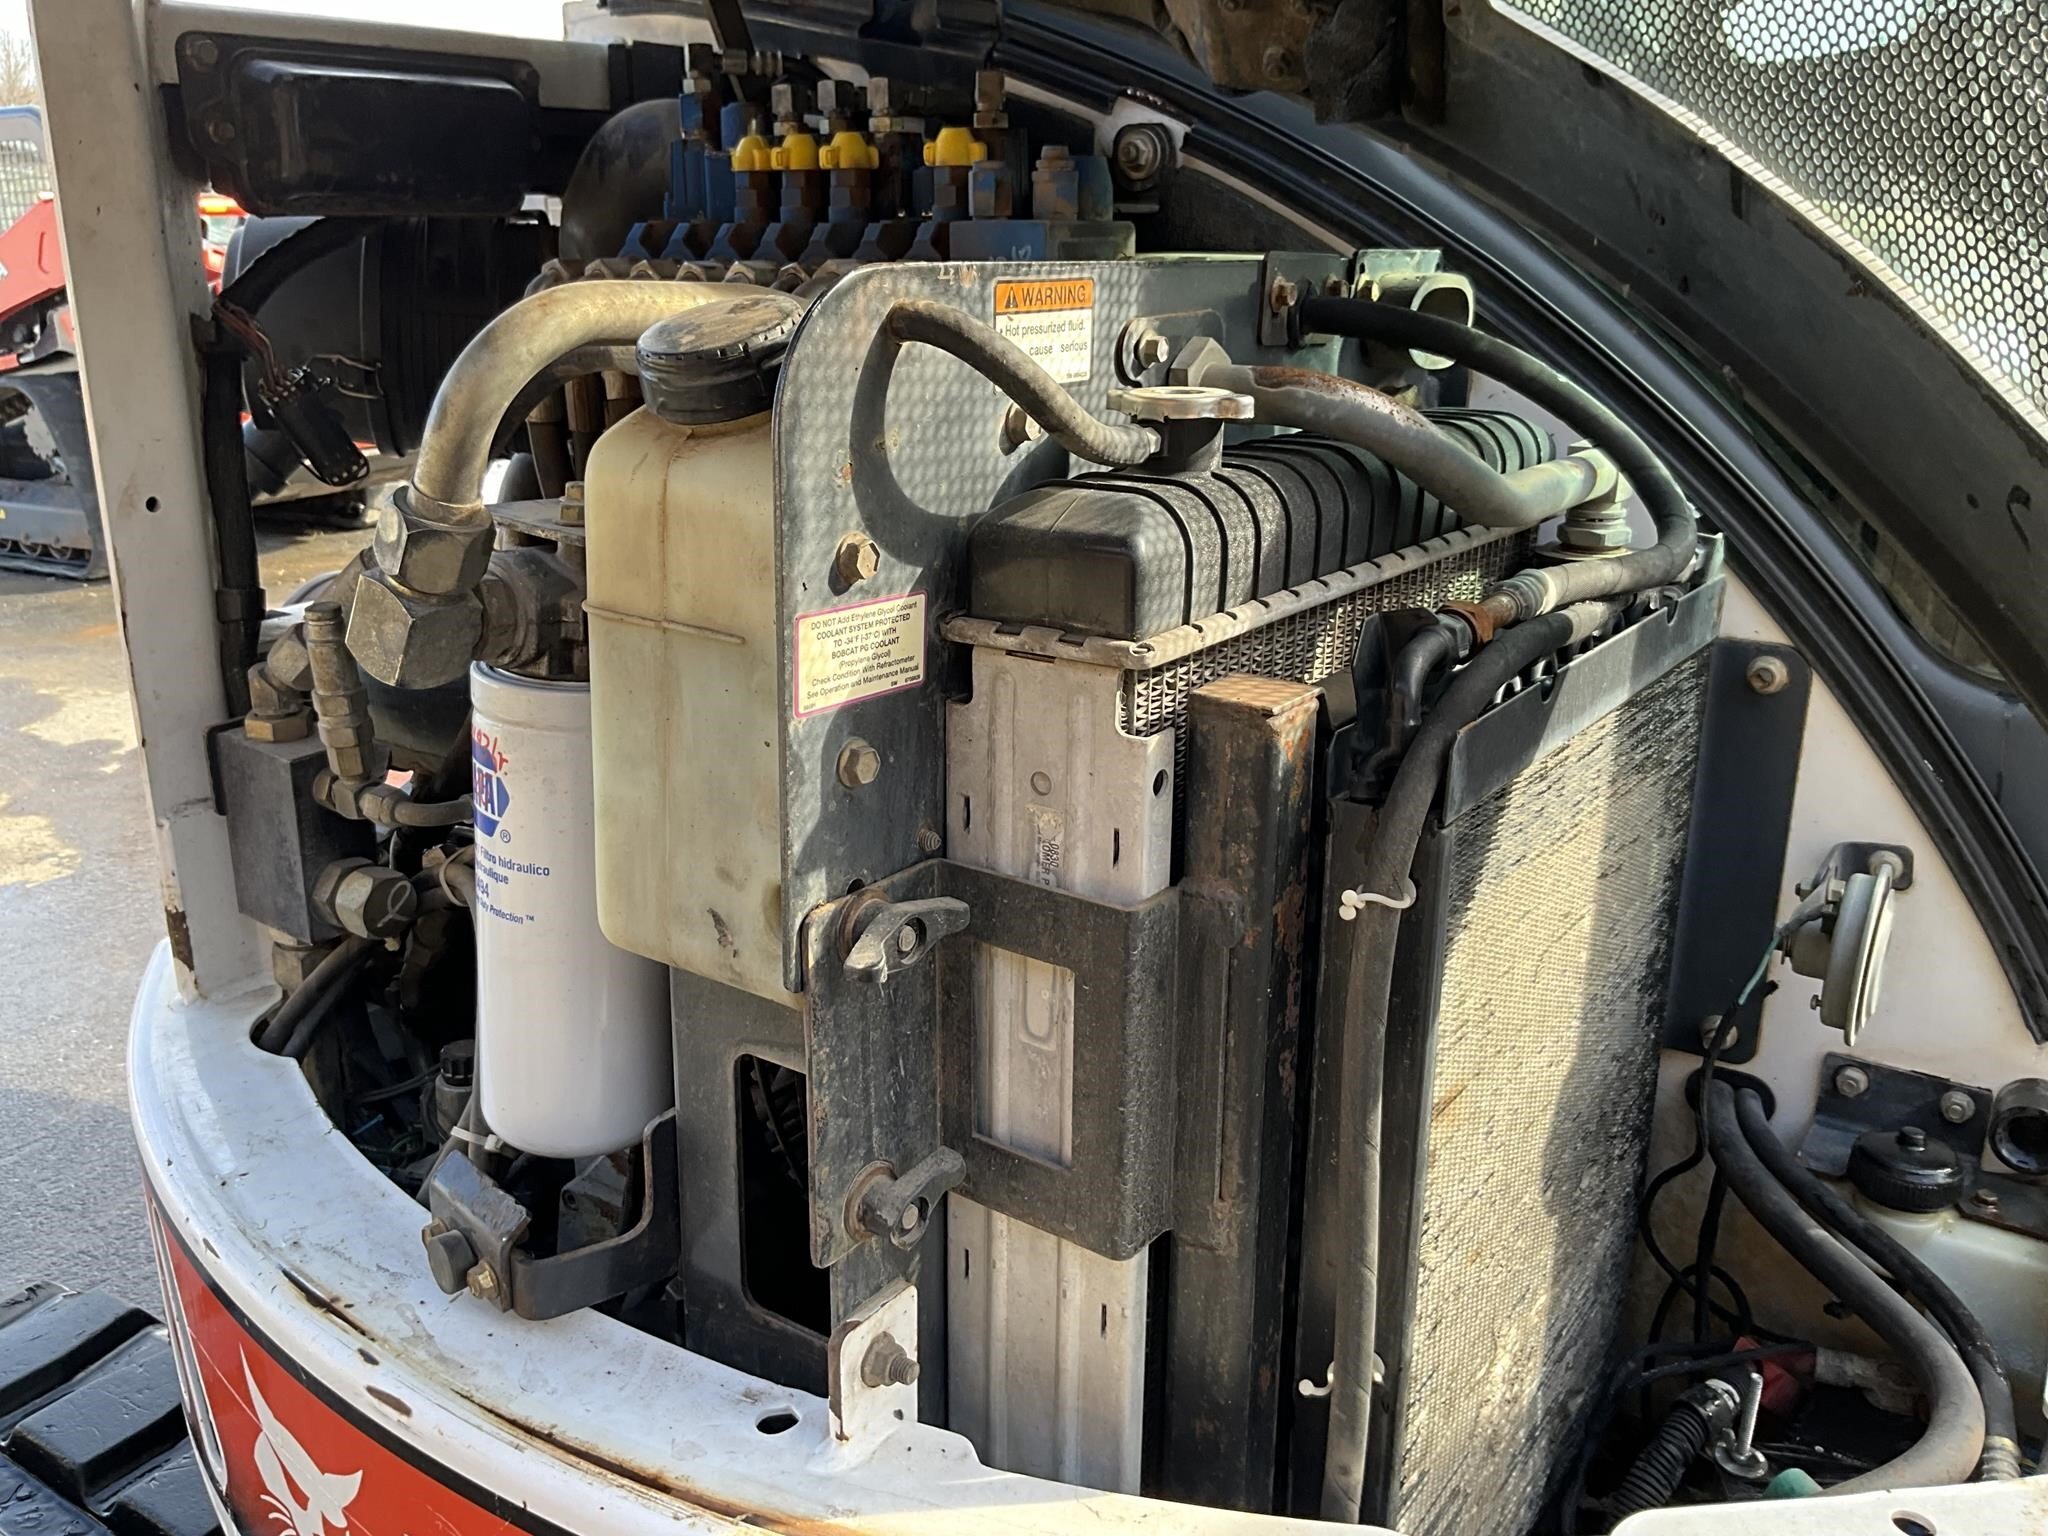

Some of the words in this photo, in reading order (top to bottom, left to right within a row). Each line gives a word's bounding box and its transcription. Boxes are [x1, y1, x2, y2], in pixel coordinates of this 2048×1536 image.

[1021, 285, 1086, 307] WARNING
[1005, 324, 1020, 337] Hot
[1021, 320, 1066, 338] pressurized
[1068, 319, 1086, 332] fluid.
[1029, 345, 1053, 356] cause
[1060, 340, 1088, 353] serious
[811, 621, 821, 630] DO
[823, 618, 836, 628] NOT
[837, 616, 850, 625] Add
[851, 610, 876, 622] Ethylene
[877, 607, 895, 617] Glycol
[896, 601, 918, 612] Coolant
[816, 627, 847, 641] COOLANT
[848, 621, 874, 634] SYSTEM
[875, 613, 911, 626] PROTECTED
[834, 639, 843, 647] TO
[882, 627, 897, 637] WITH
[831, 646, 858, 659] BOBCAT
[859, 643, 869, 653] PG
[870, 636, 900, 650] COOLANT
[807, 690, 819, 700] See
[820, 682, 850, 698] Operation
[850, 679, 862, 688] and
[862, 670, 898, 684] Maintenance
[899, 664, 920, 675] Manual
[811, 676, 831, 687] Check
[832, 669, 862, 681] Condition
[862, 664, 875, 674] With
[876, 655, 916, 671] Refractometer
[498, 855, 551, 877] hidraulico
[489, 904, 524, 925] Protection
